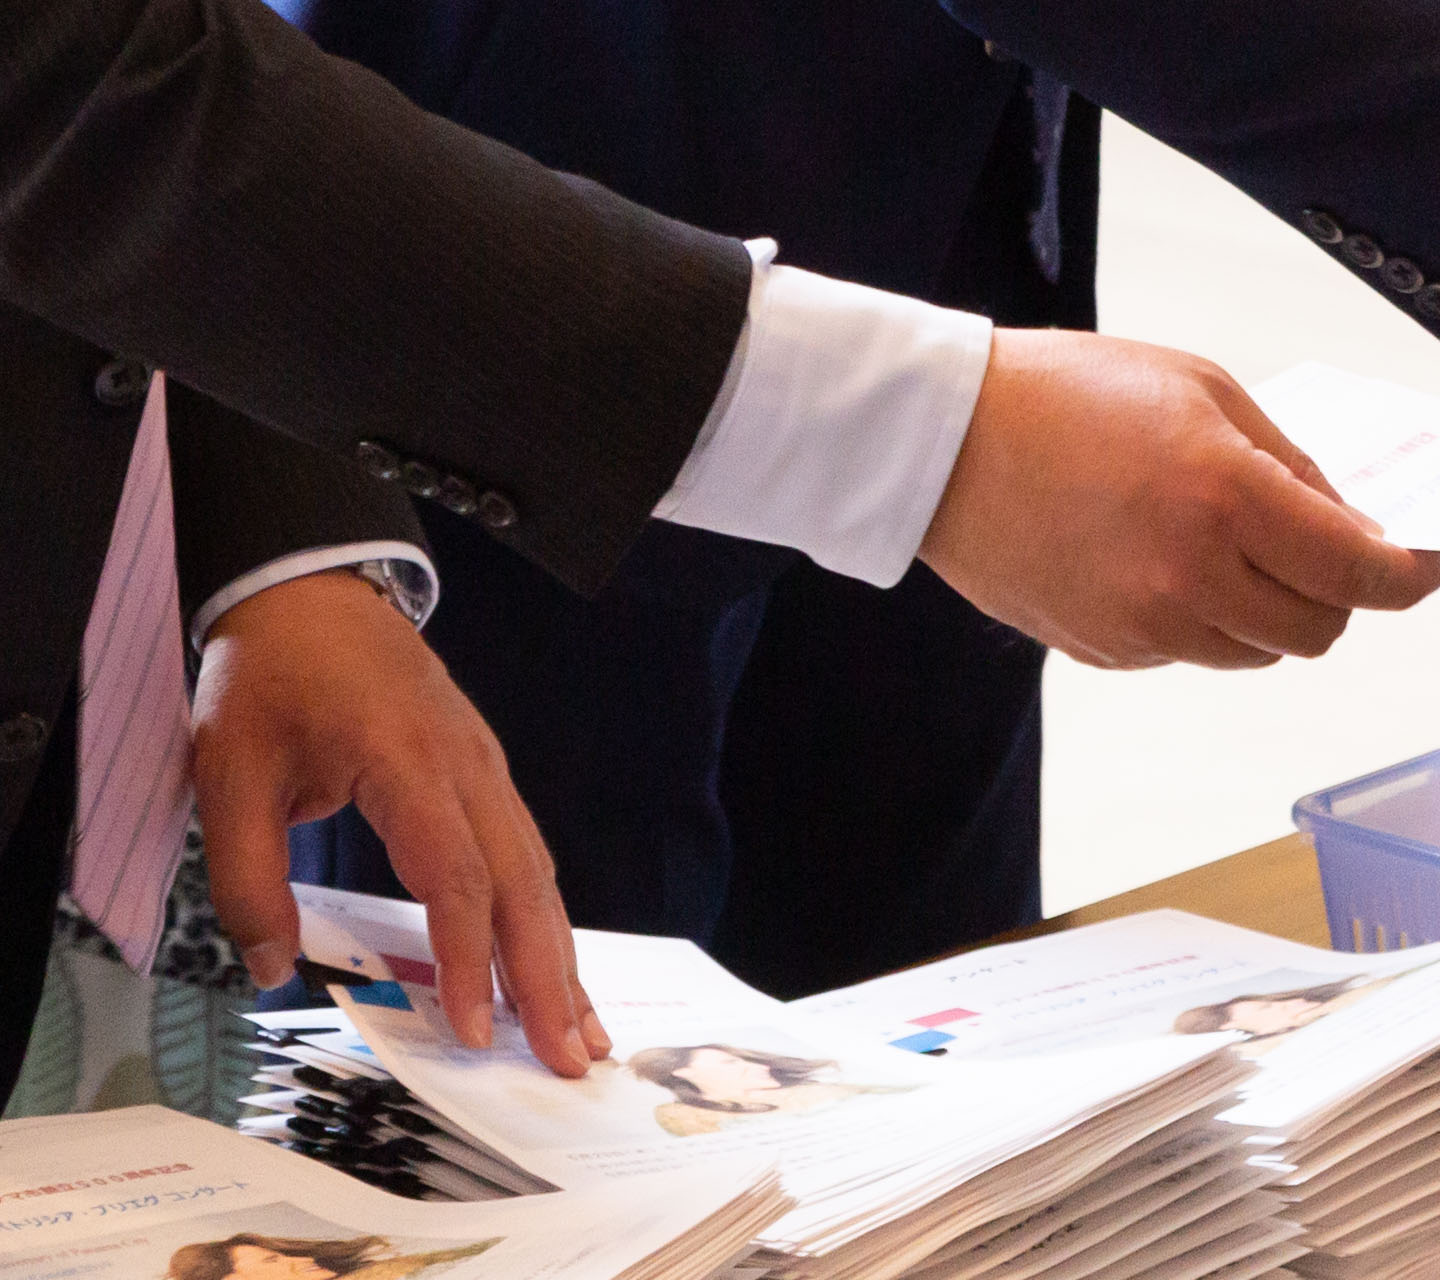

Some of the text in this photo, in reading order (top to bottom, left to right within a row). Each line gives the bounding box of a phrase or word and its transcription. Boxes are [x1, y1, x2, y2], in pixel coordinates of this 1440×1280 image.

[164, 1179, 251, 1202] コンサート
